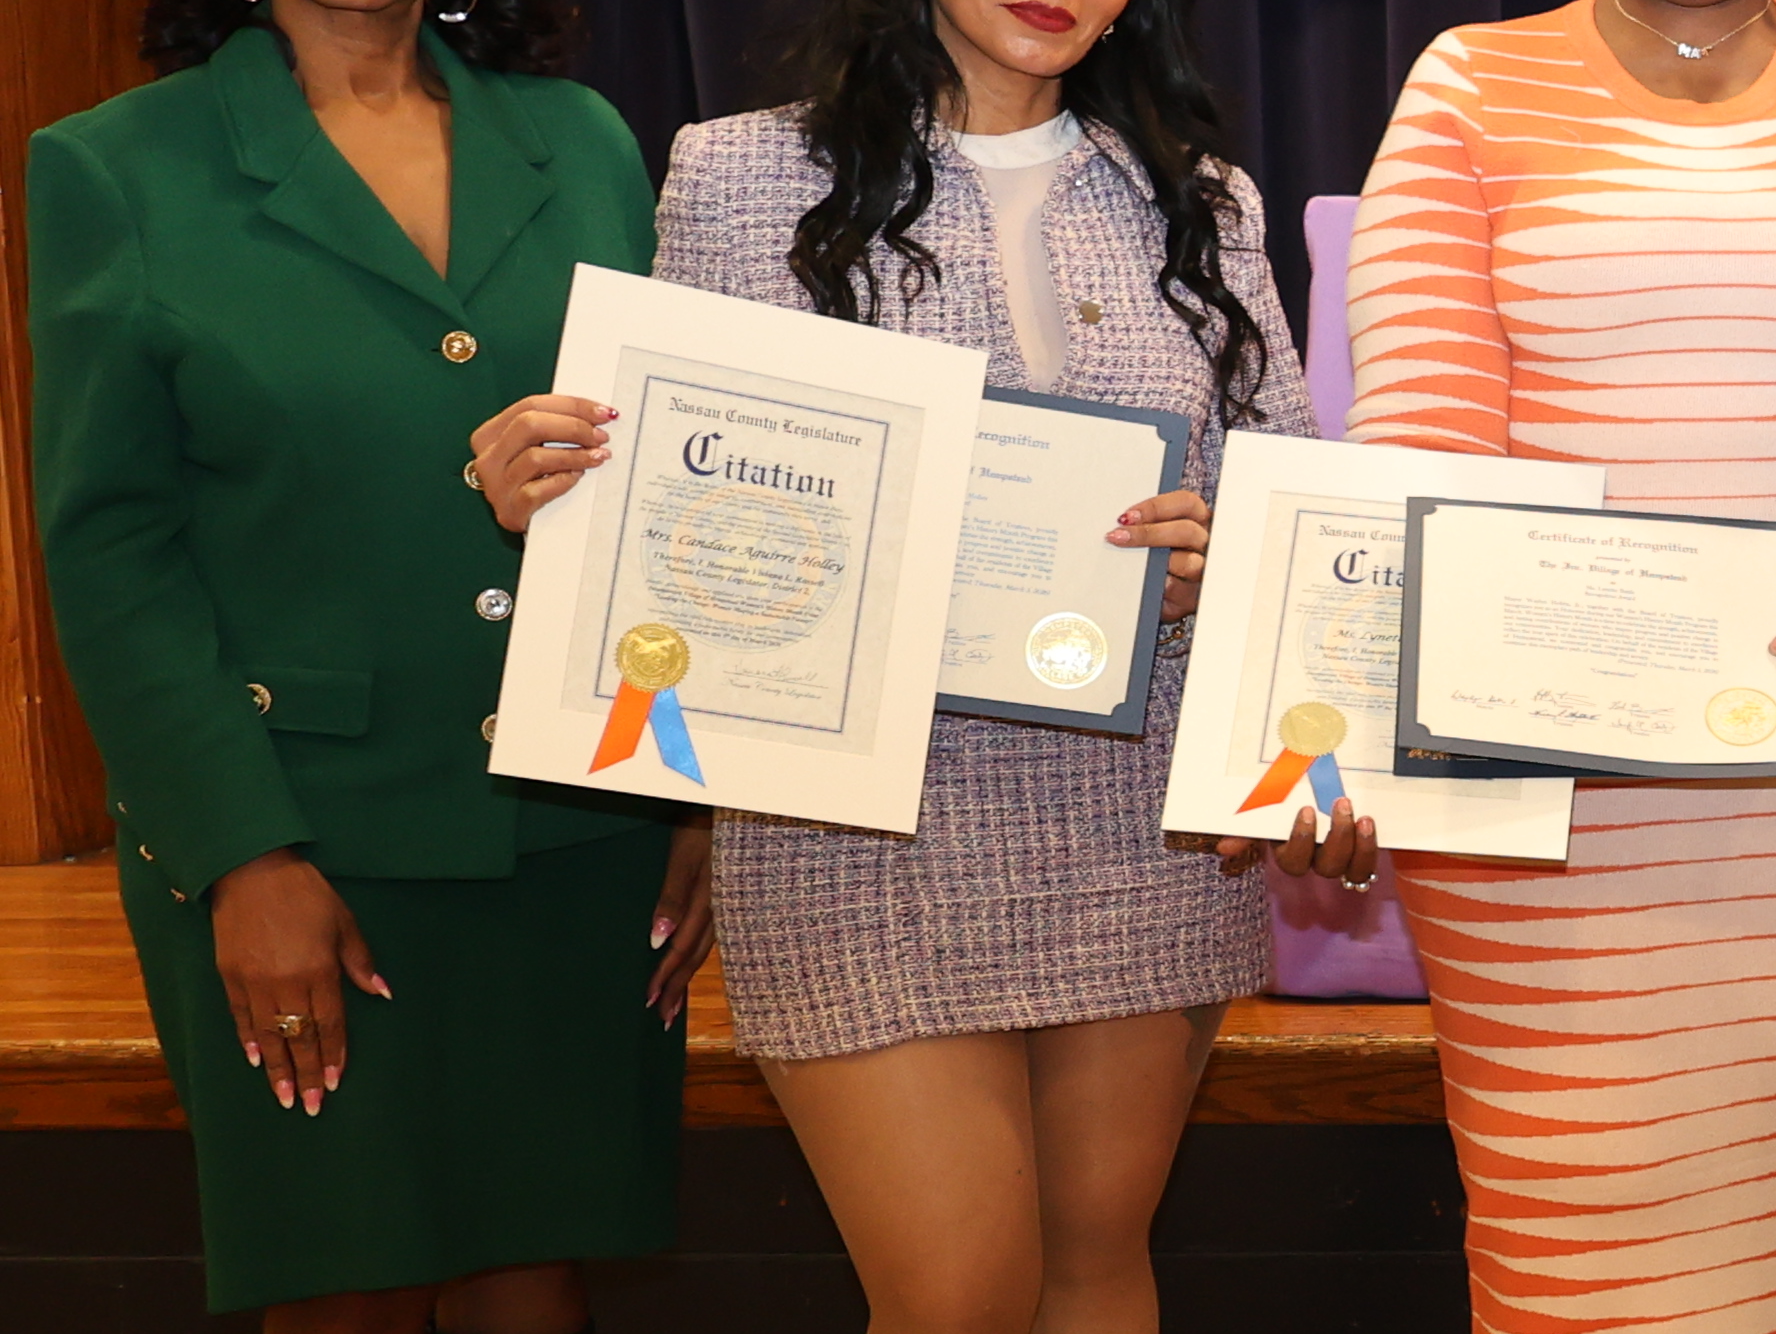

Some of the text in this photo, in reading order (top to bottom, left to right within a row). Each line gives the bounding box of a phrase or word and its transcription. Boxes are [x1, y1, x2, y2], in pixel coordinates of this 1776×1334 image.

[668, 397, 862, 446] Nassau County Legislature
[975, 431, 1051, 450] ecognition
[682, 430, 836, 498] Citation
[1319, 525, 1406, 543] Nassau Coun
[1527, 530, 1699, 555] Certificate of Recognition
[678, 535, 737, 554] Candace
[739, 547, 796, 565] Aguirre
[797, 552, 846, 575] Holley
[1333, 548, 1404, 588] Cita
